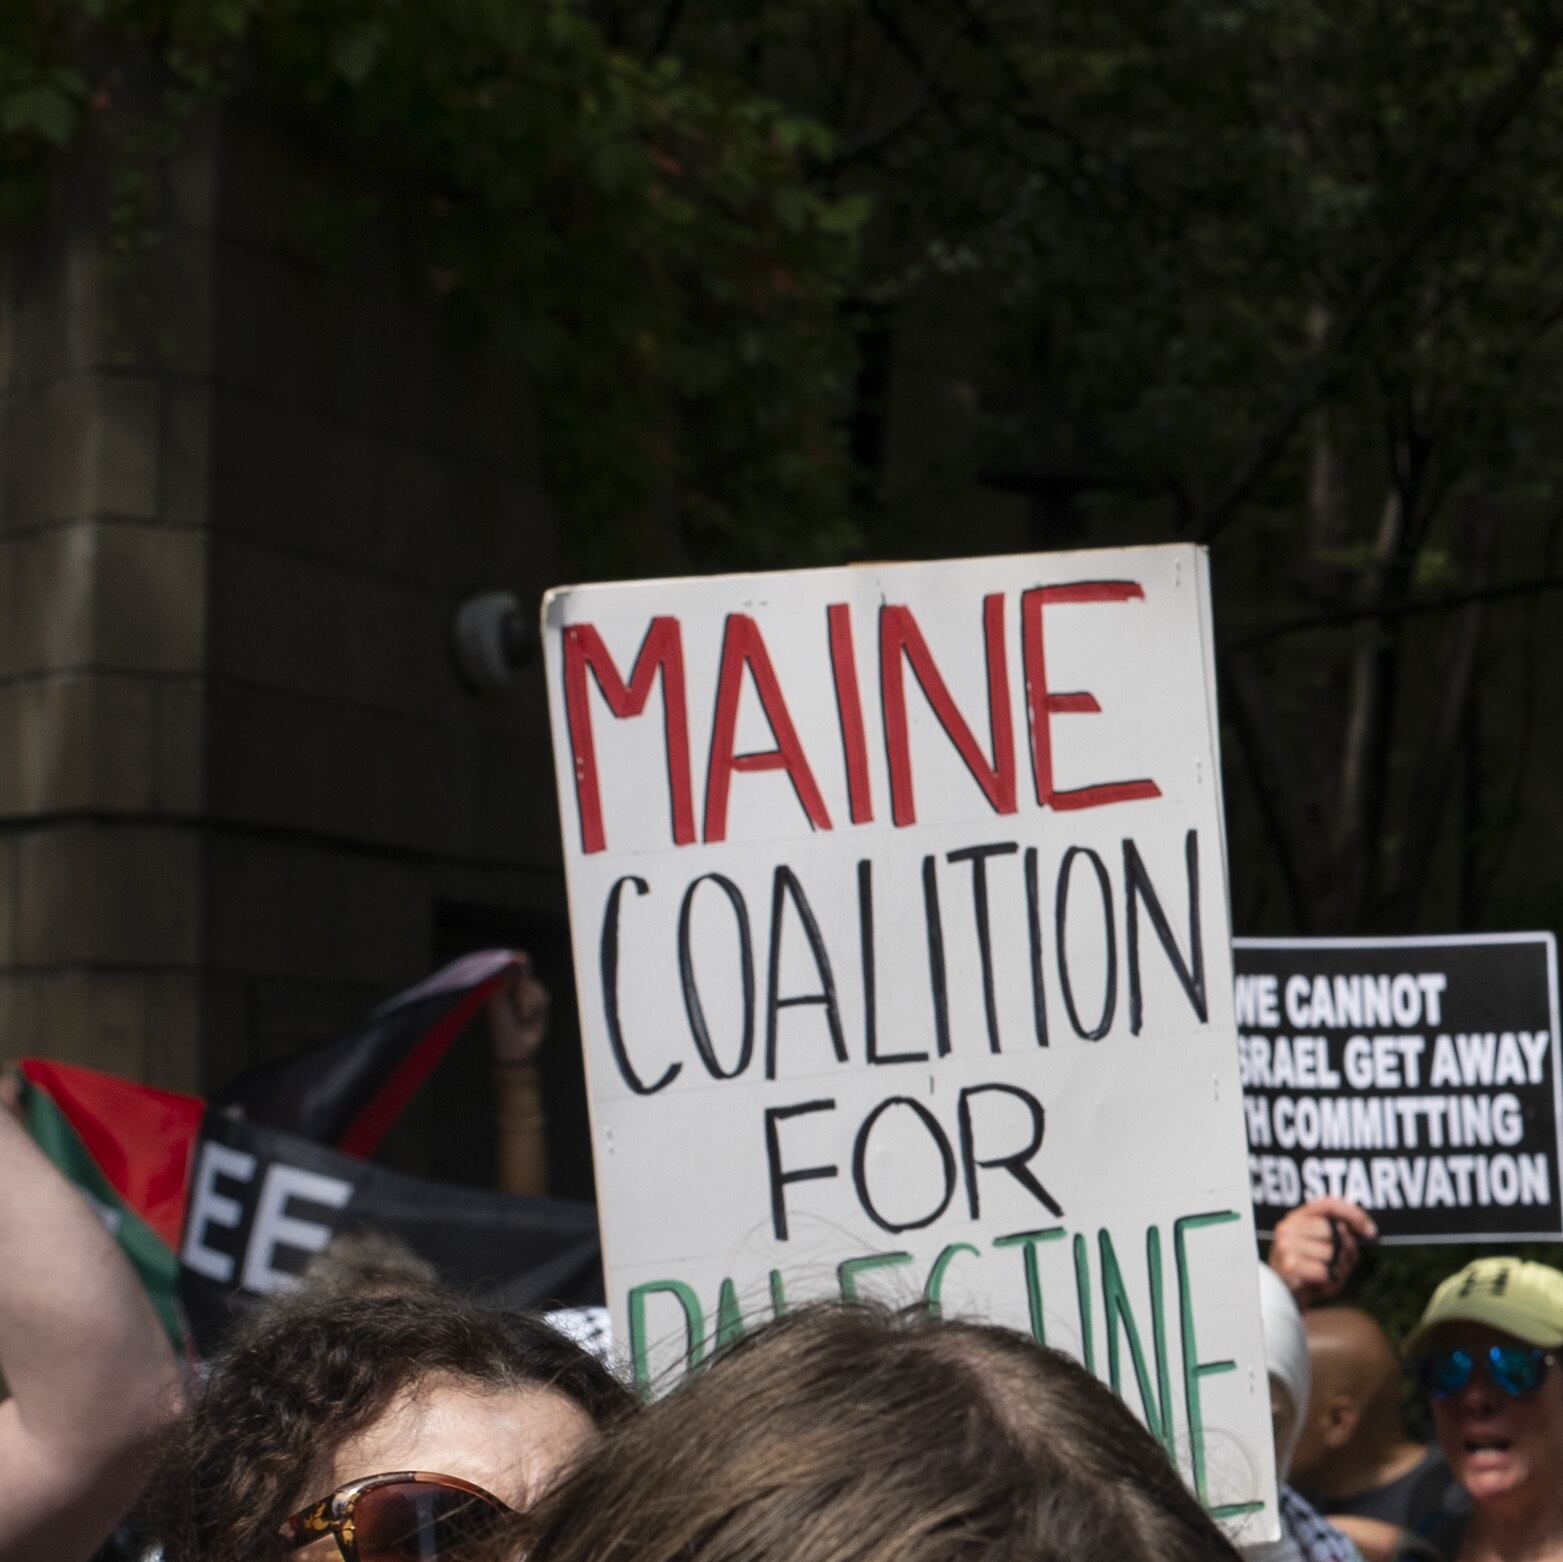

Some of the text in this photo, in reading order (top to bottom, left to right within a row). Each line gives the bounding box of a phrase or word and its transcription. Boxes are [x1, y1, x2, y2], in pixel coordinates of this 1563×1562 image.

[561, 579, 1162, 855] MAINE
[600, 828, 1210, 1095] COALITION
[1285, 973, 1447, 1028] CANNOT
[1344, 1035, 1426, 1089] GET
[1430, 1031, 1550, 1087] AWAY
[1273, 1093, 1524, 1149] COMMITTING
[764, 1082, 1064, 1241] FOR
[1301, 1153, 1550, 1210] STARVATION
